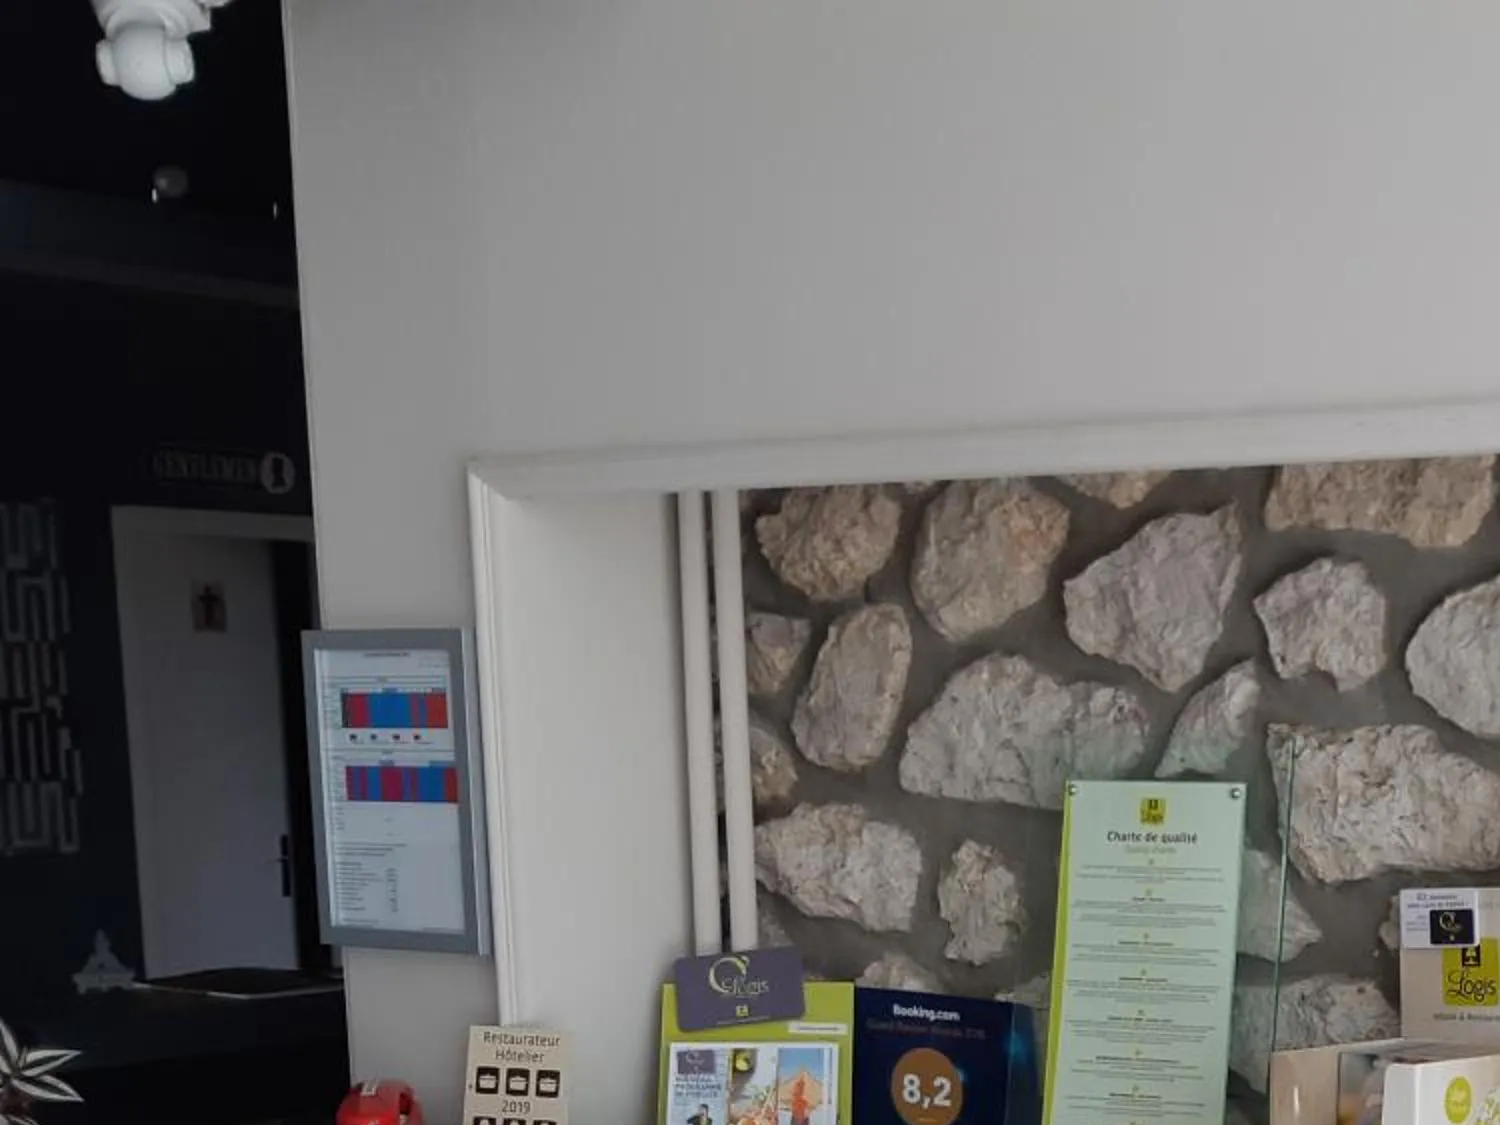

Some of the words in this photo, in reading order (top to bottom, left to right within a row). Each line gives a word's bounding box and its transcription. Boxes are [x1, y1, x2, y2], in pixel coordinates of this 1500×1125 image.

[1107, 831, 1142, 844] Charte
[1145, 831, 1159, 843] de
[1161, 831, 1198, 845] qualité
[1446, 967, 1497, 1003] Logis
[892, 1003, 961, 1022] Booking.com
[483, 1031, 560, 1047] Restaurateur
[495, 1048, 545, 1063] Hôtelier
[902, 1073, 952, 1110] 8,2
[501, 1100, 531, 1113] 2019
